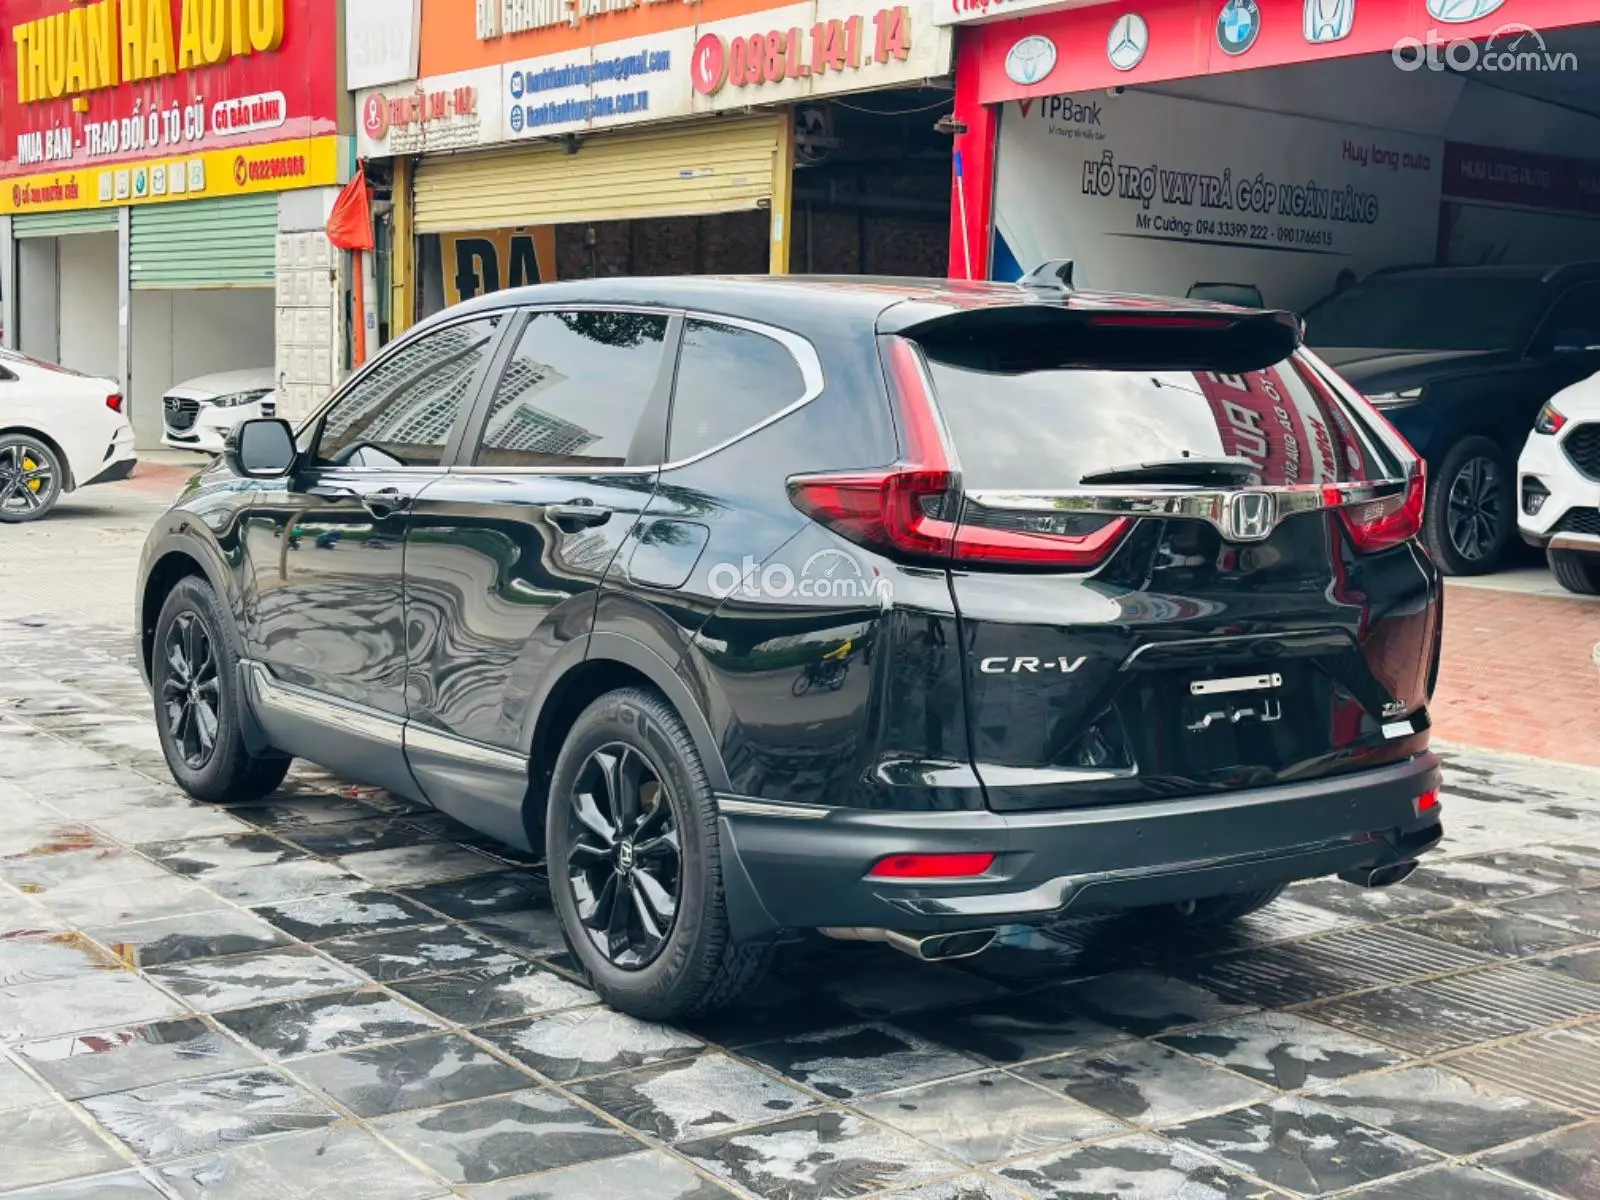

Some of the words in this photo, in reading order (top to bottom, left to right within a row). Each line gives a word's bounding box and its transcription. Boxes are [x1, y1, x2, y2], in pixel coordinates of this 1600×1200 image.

[179, 0, 285, 70] AUTO
[215, 103, 228, 129] CÓ
[230, 99, 250, 128] BẢO
[251, 97, 280, 123] HÀNH
[17, 131, 42, 165] MUA
[45, 119, 73, 160] BÁN
[84, 119, 119, 156] TRAO
[121, 98, 145, 151] ĐỔI
[148, 103, 159, 147] Ô
[162, 100, 181, 144] TÔ
[185, 95, 205, 141] CŨ
[1342, 139, 1368, 167] Huy
[1372, 144, 1399, 171] long
[1402, 153, 1431, 171] auto
[1082, 149, 1114, 197] HỖ
[1118, 164, 1158, 211] TRỢ
[1159, 170, 1198, 206] VAY
[1198, 167, 1233, 211] TRẢ
[1236, 172, 1277, 214] GÓP
[1278, 179, 1329, 220] NGÂN
[1329, 184, 1379, 225] HÀNG
[1136, 213, 1151, 229] Mr
[1196, 219, 1215, 236] 094
[1217, 221, 1249, 239] 33399
[1250, 224, 1268, 240] 222
[980, 656, 1088, 673] CR-V
